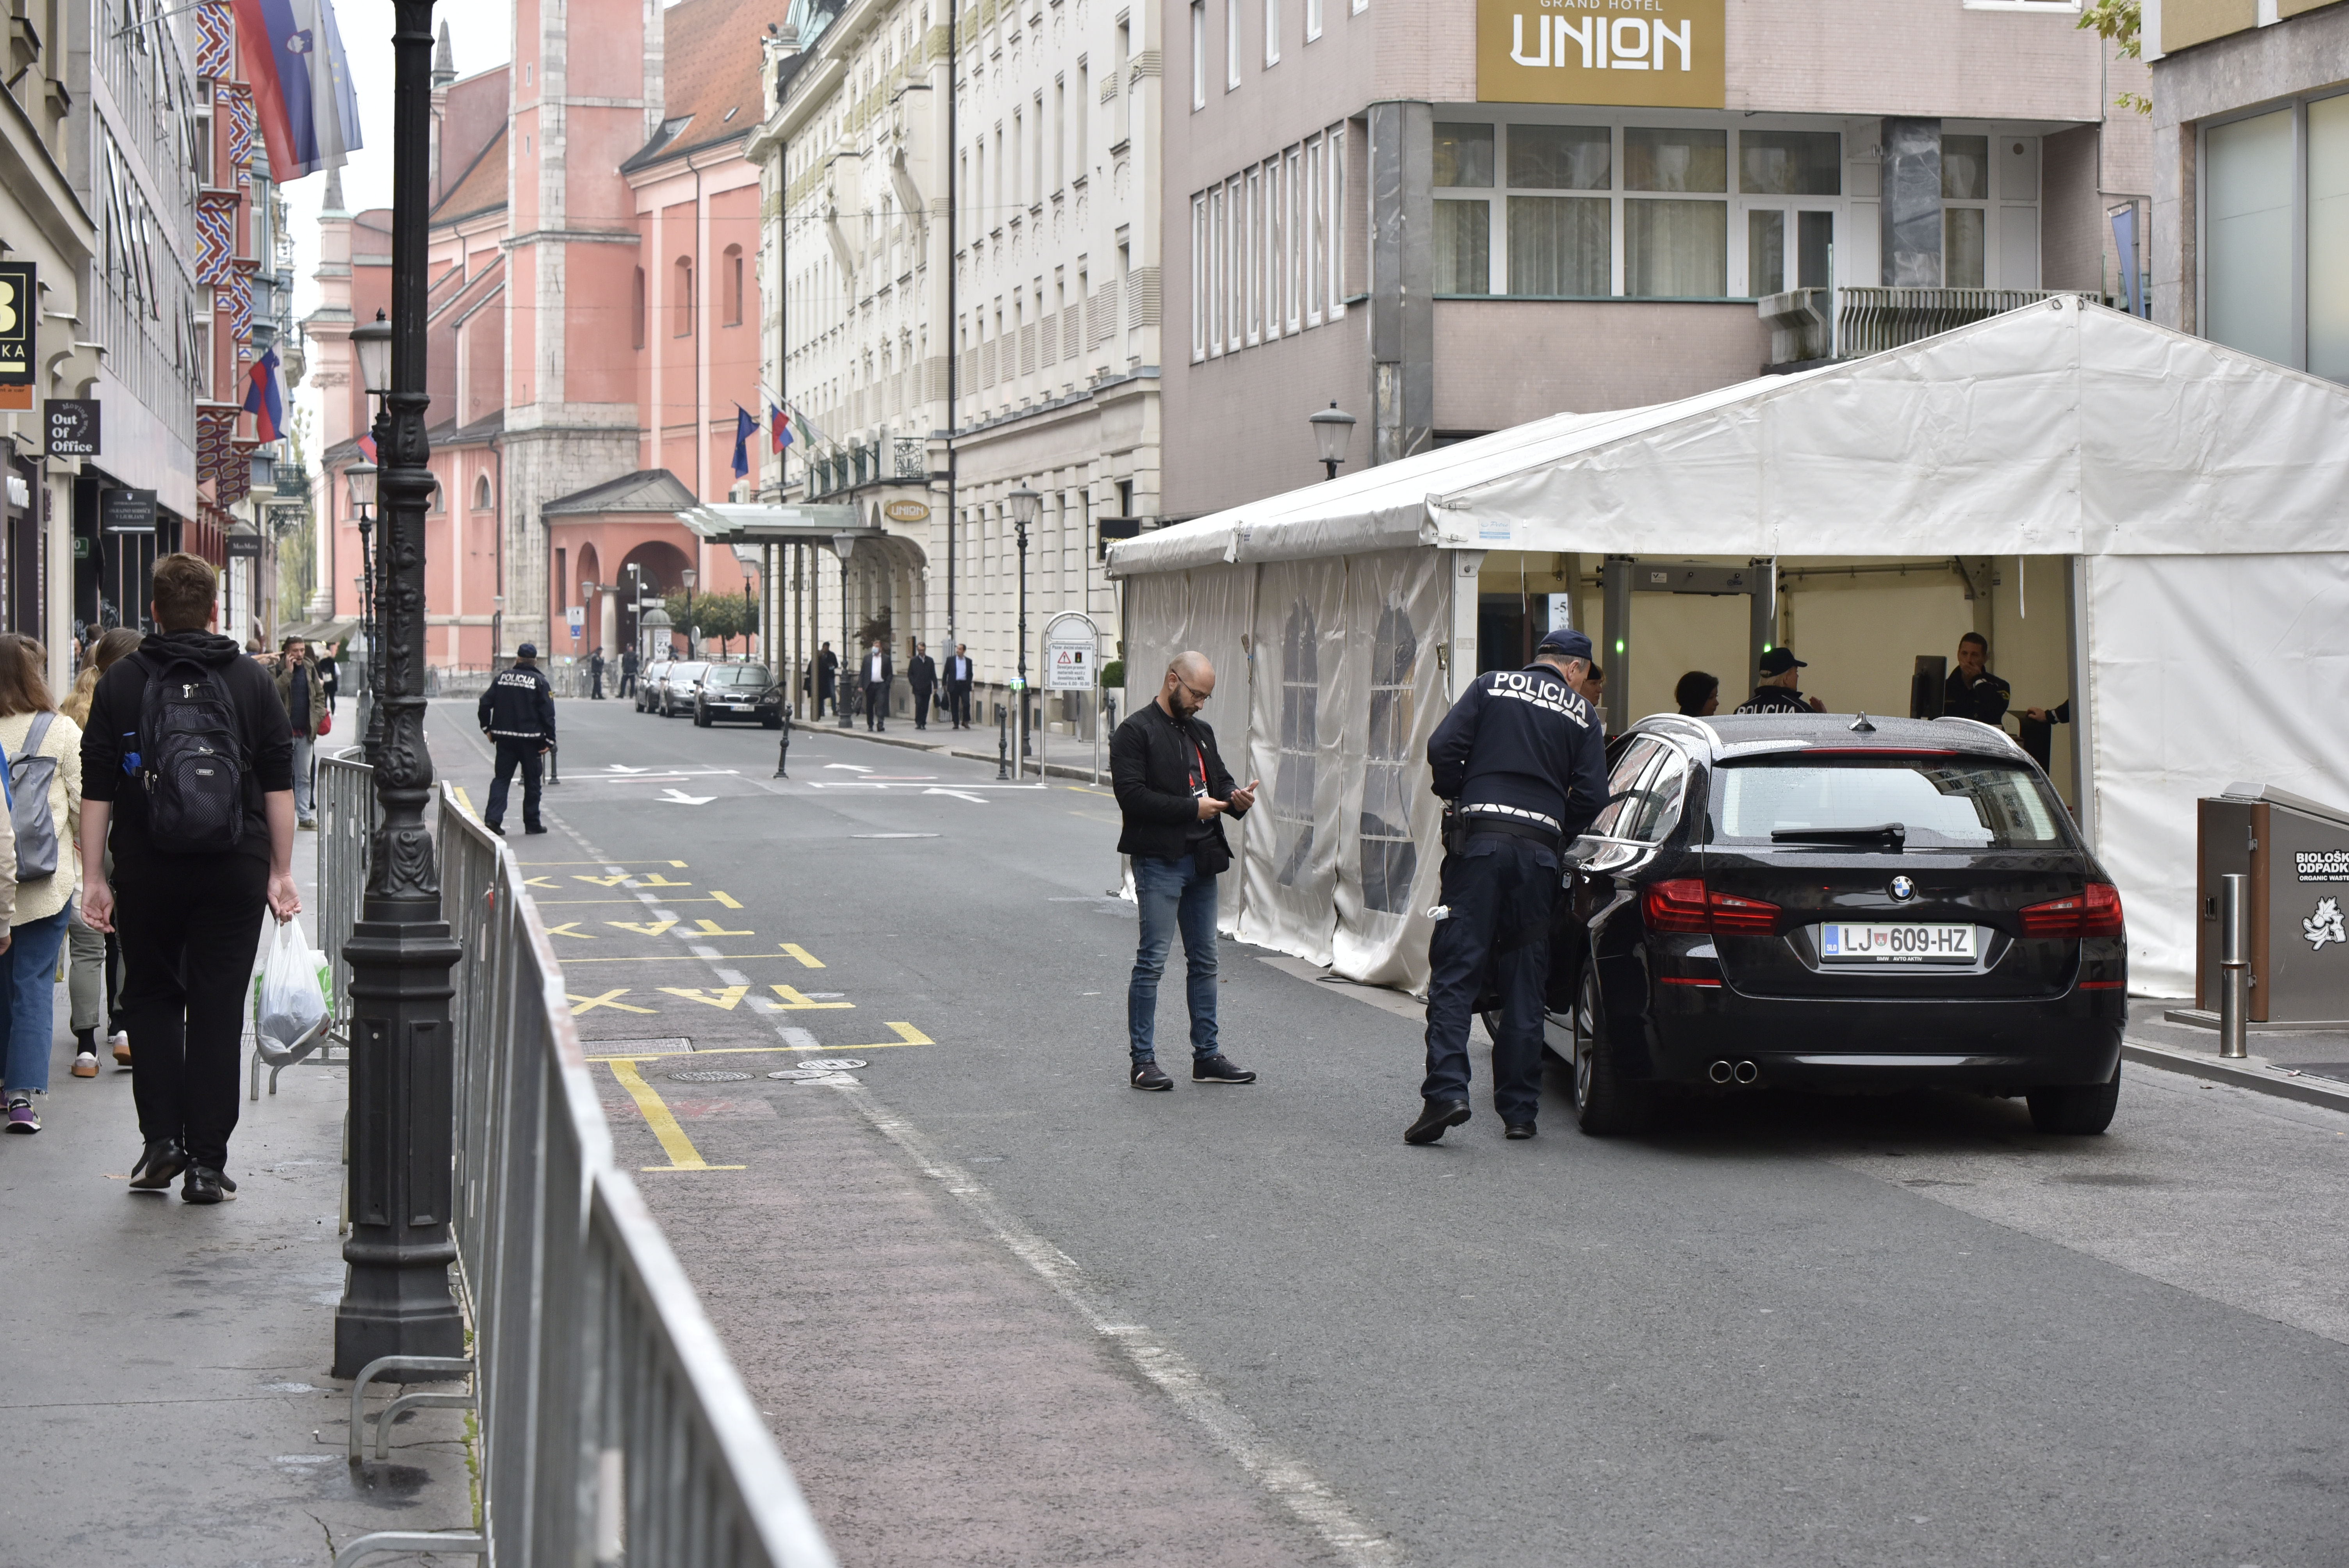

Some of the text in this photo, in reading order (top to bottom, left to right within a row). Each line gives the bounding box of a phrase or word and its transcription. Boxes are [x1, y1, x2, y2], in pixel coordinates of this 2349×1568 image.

[1540, 0, 1663, 11] GRAND HOTEL
[1510, 14, 1691, 71] UNION
[52, 413, 78, 425] Out
[52, 427, 70, 438] Of
[52, 440, 93, 452] Office
[891, 506, 924, 516] UNION
[500, 674, 535, 686] POLICIJA
[1494, 673, 1586, 720] POLICIJA
[2298, 863, 2349, 873] ODPADK
[1844, 928, 1968, 952] LJ 609-HZ
